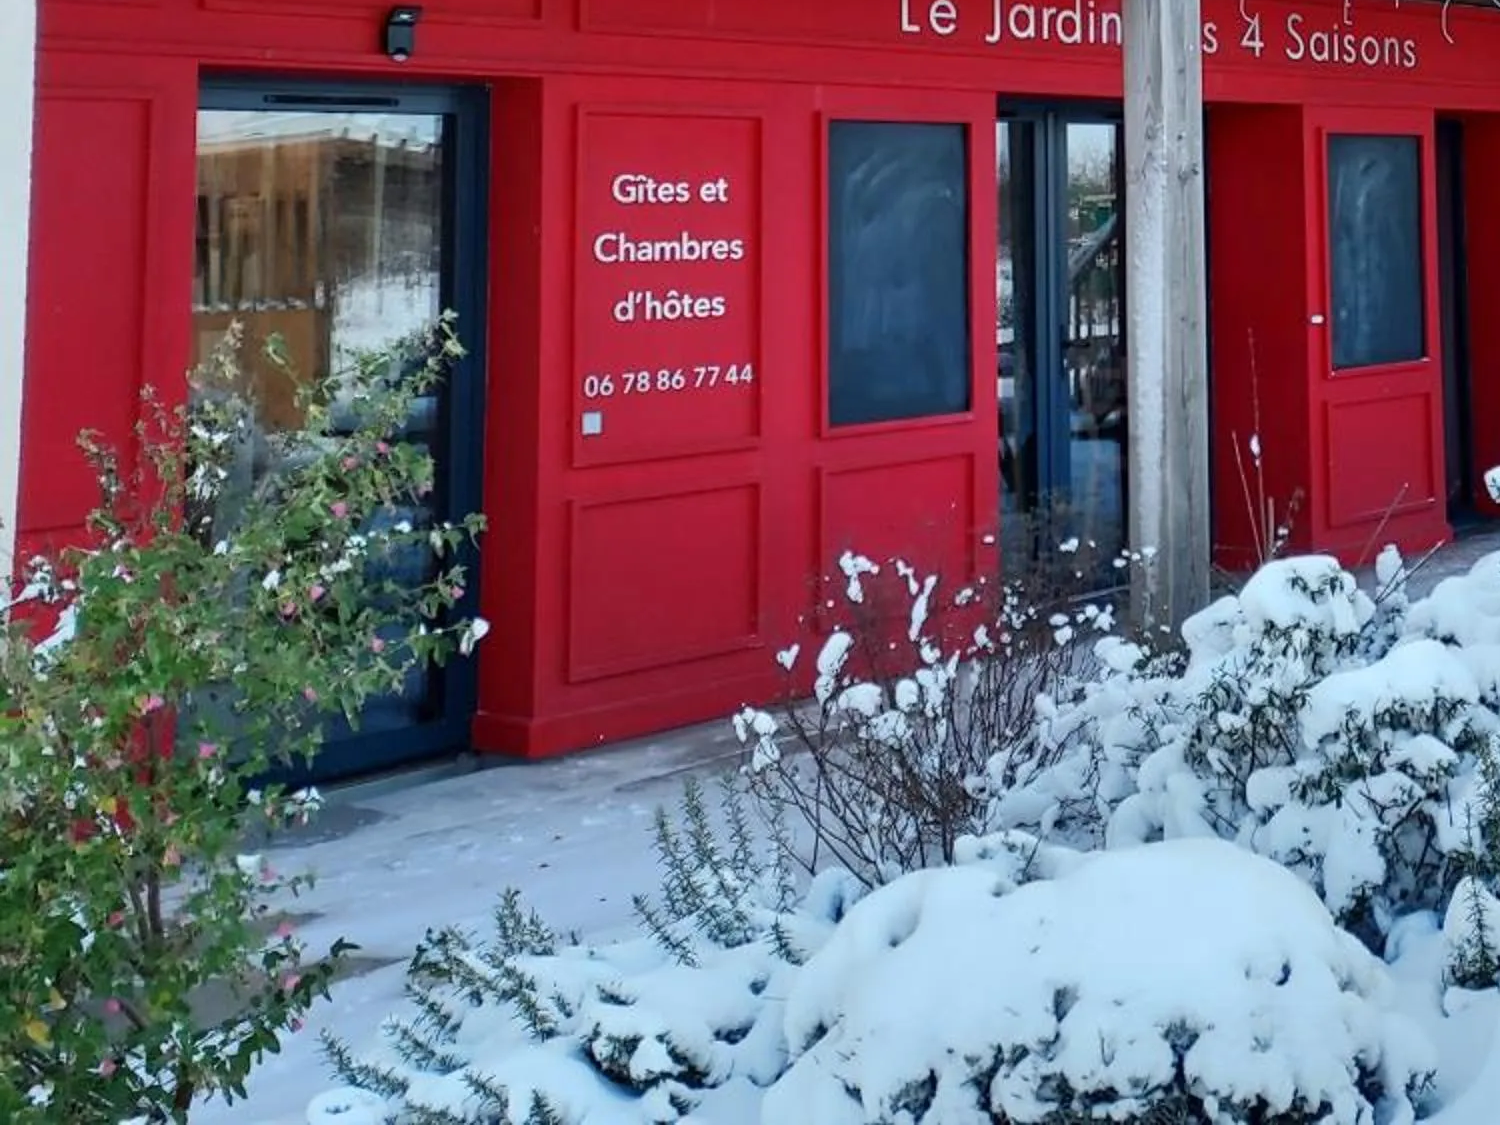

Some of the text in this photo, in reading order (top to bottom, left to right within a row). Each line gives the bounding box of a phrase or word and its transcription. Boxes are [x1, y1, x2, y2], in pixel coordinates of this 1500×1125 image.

[1241, 10, 1264, 57] 4
[1286, 14, 1417, 68] Saisons
[612, 174, 729, 204] Gîtes et
[594, 231, 744, 262] Chambres
[584, 363, 753, 398] 06 78 86 77 44
